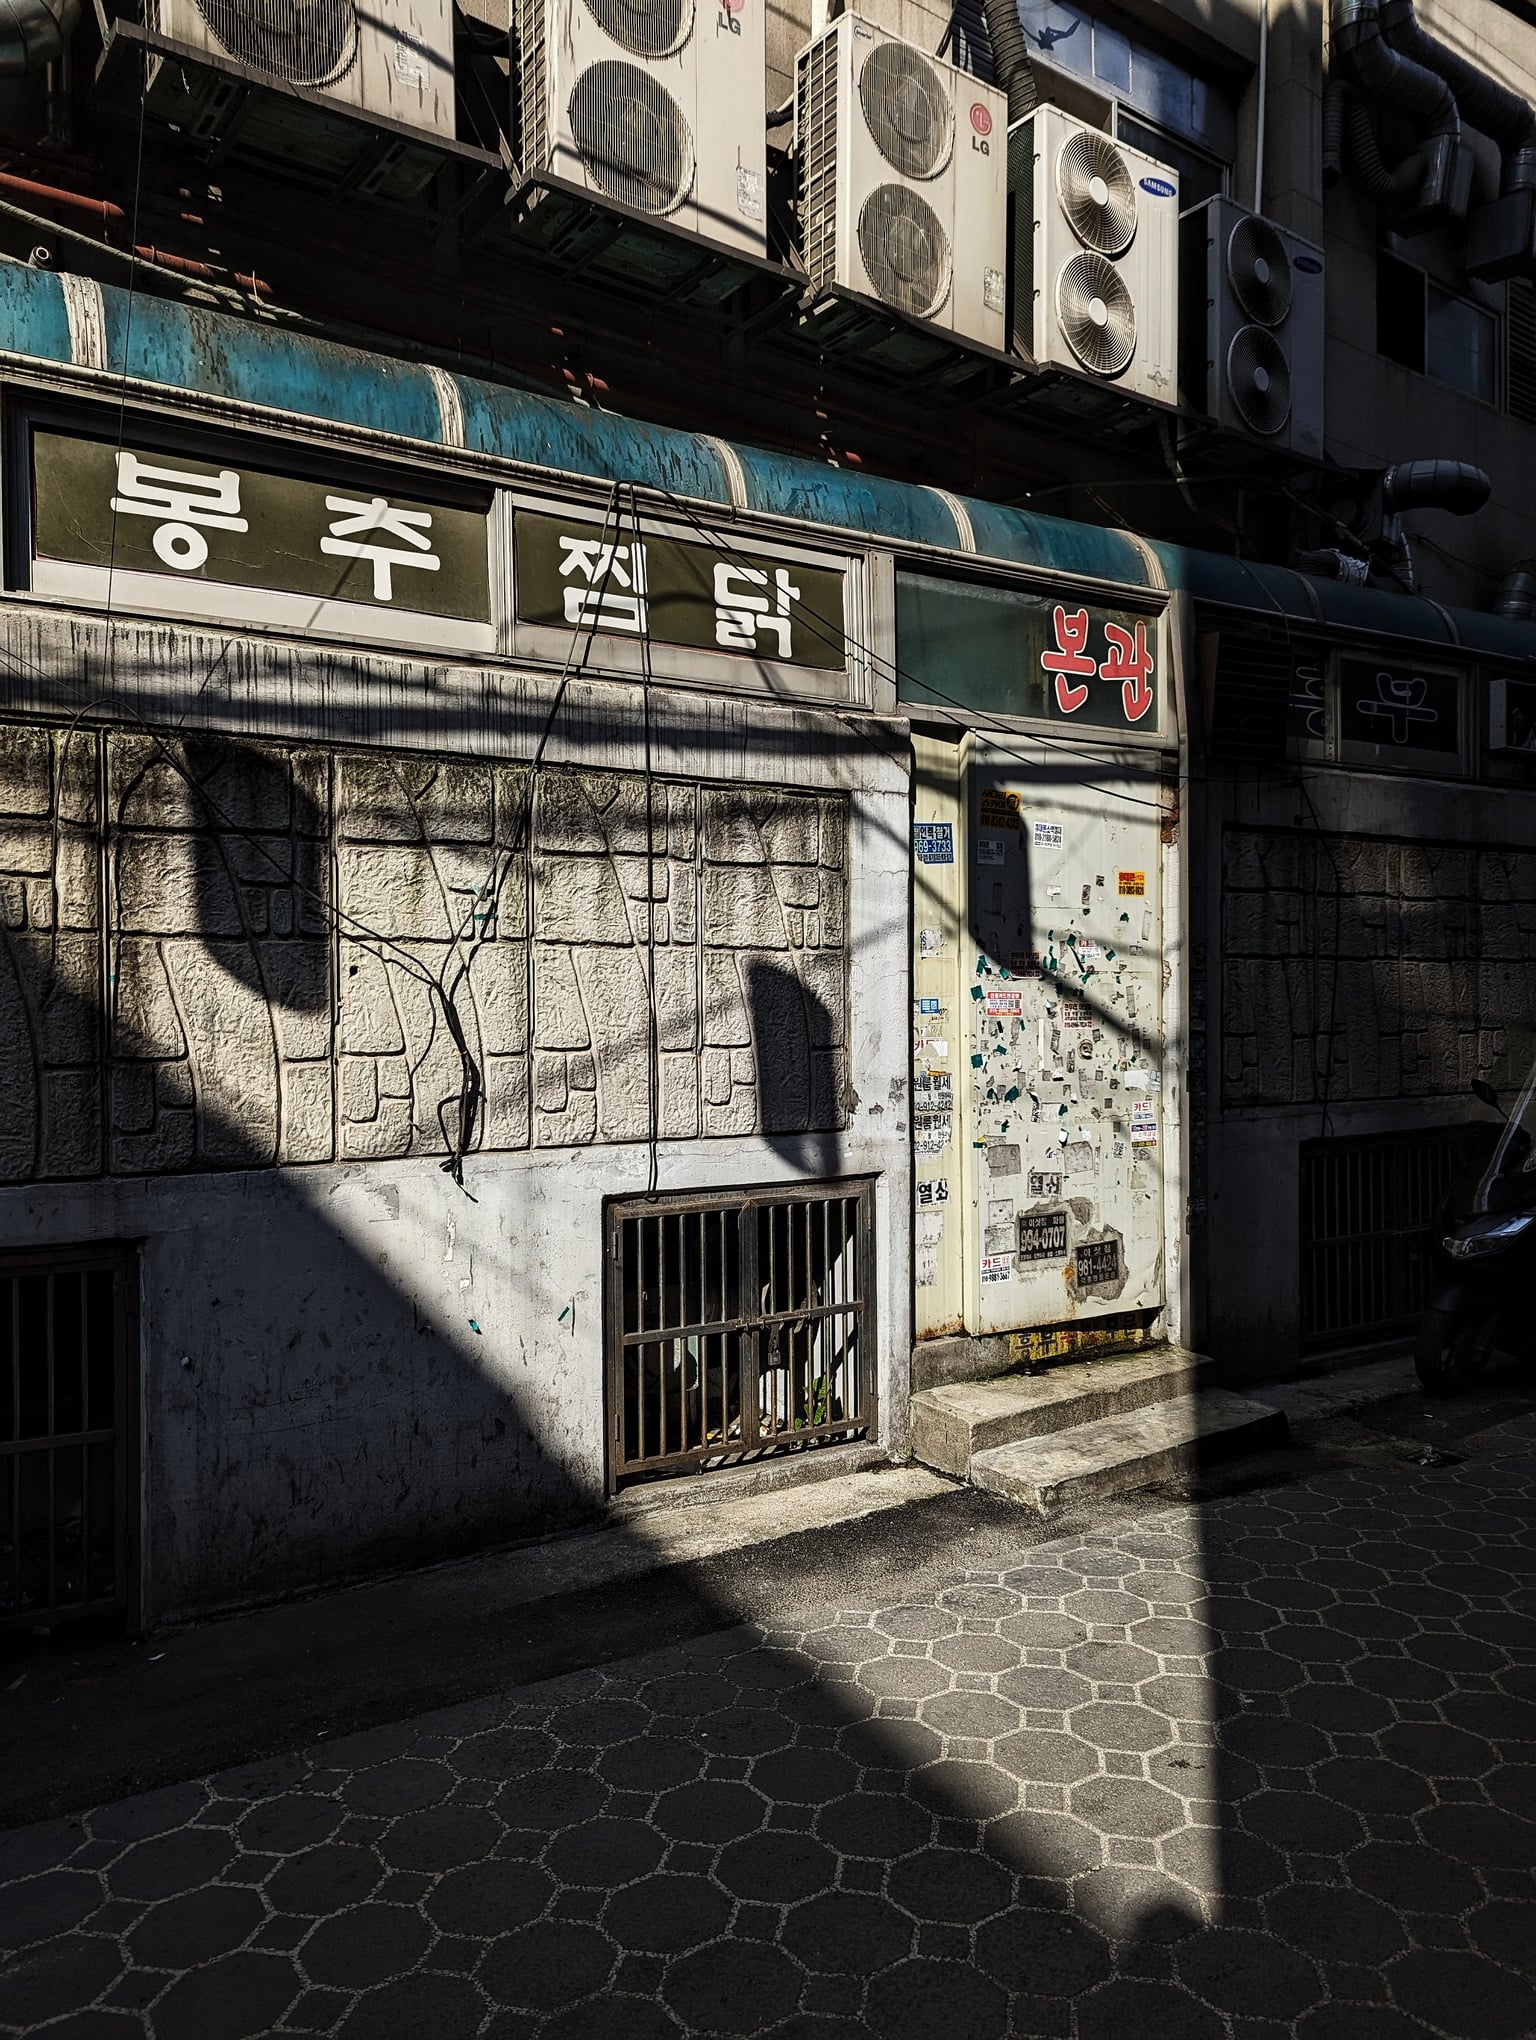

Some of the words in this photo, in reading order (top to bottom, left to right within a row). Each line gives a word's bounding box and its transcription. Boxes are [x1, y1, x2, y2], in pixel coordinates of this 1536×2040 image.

[718, 11, 741, 37] LG
[972, 136, 990, 157] LG
[1143, 177, 1173, 197] SAMSUNG
[1041, 605, 1154, 721] 본관
[1134, 1102, 1148, 1111] 카드
[1021, 1225, 1065, 1252] 994-0707
[982, 1257, 1001, 1268] 카드
[1078, 1253, 1117, 1277] 981-4424
